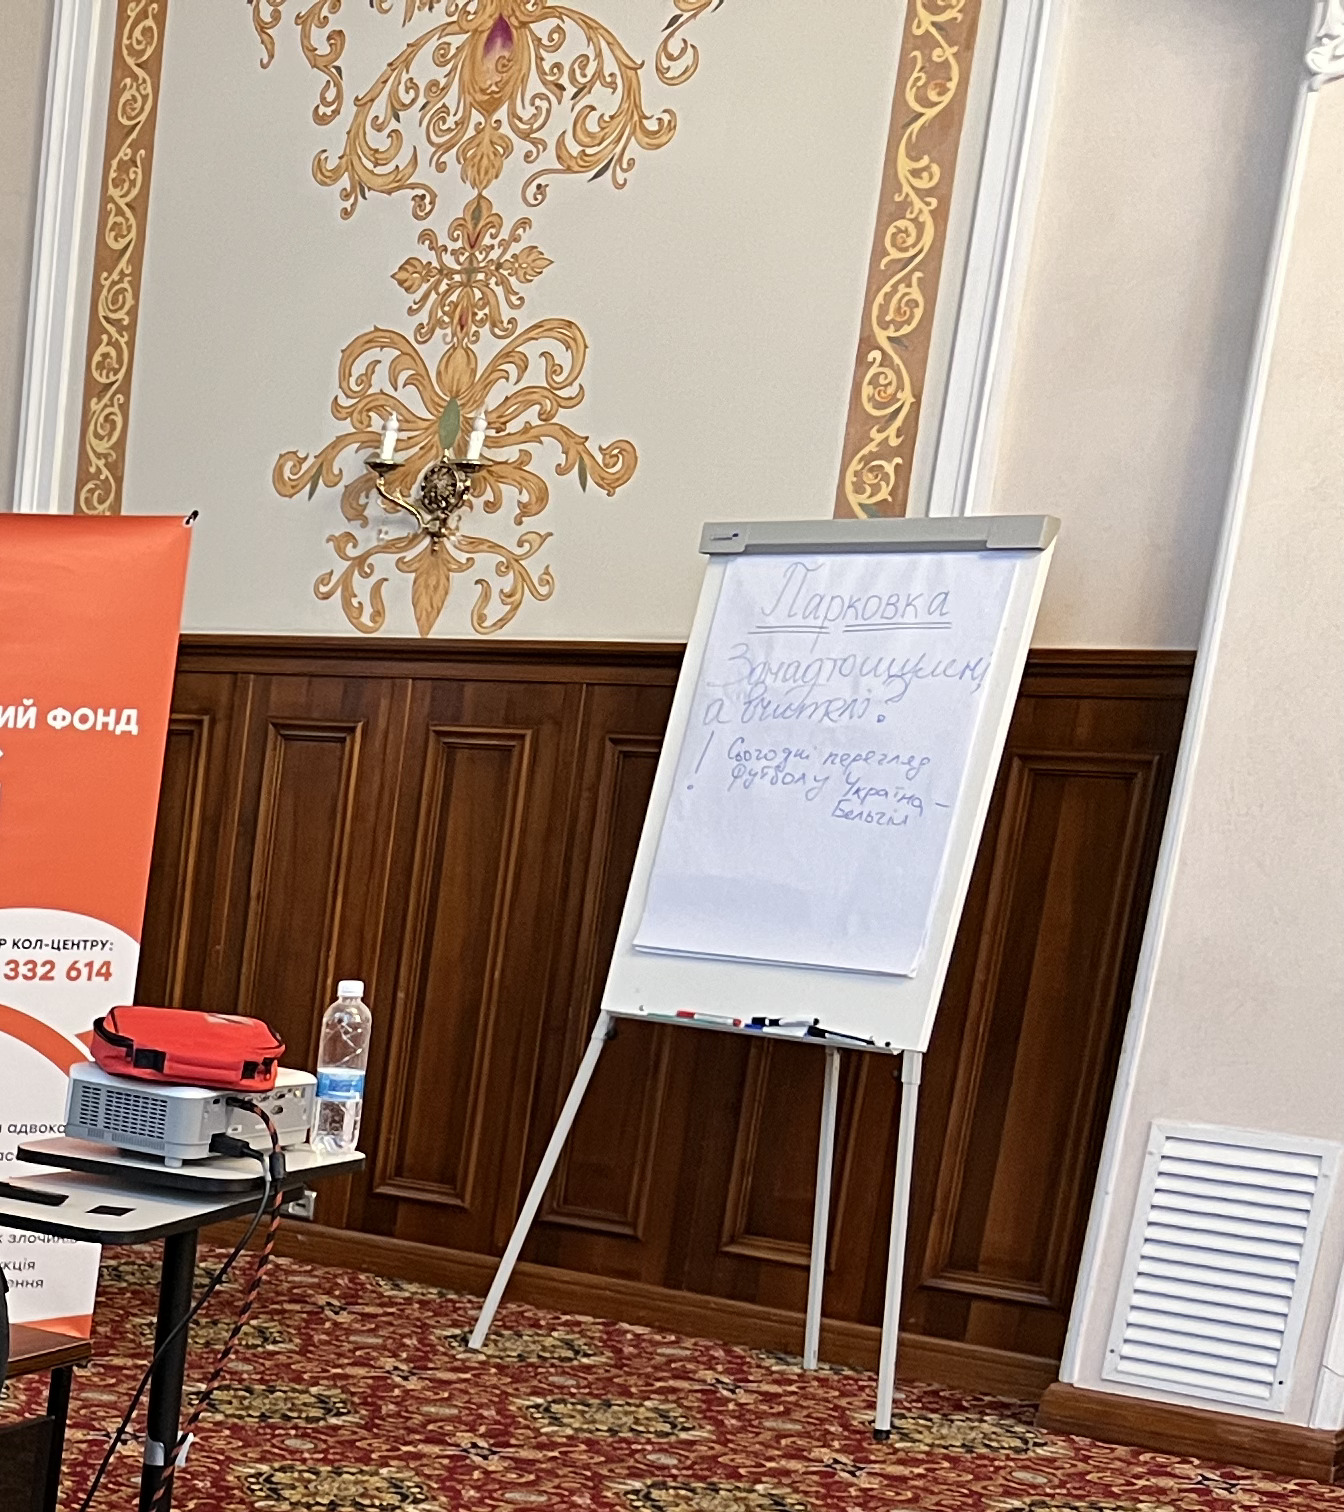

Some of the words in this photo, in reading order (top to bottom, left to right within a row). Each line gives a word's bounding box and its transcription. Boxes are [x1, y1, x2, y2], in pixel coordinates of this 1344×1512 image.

[762, 562, 950, 646] Парковка
[46, 707, 138, 735] ФОНД
[703, 698, 731, 725] а
[727, 736, 816, 771] Сьогодні
[822, 750, 931, 781] перегляд
[12, 938, 113, 951] КОЛ-ЦЕНТРУ:
[3, 959, 56, 981] 332
[65, 960, 113, 982] 614
[7, 1123, 67, 1136] адвока
